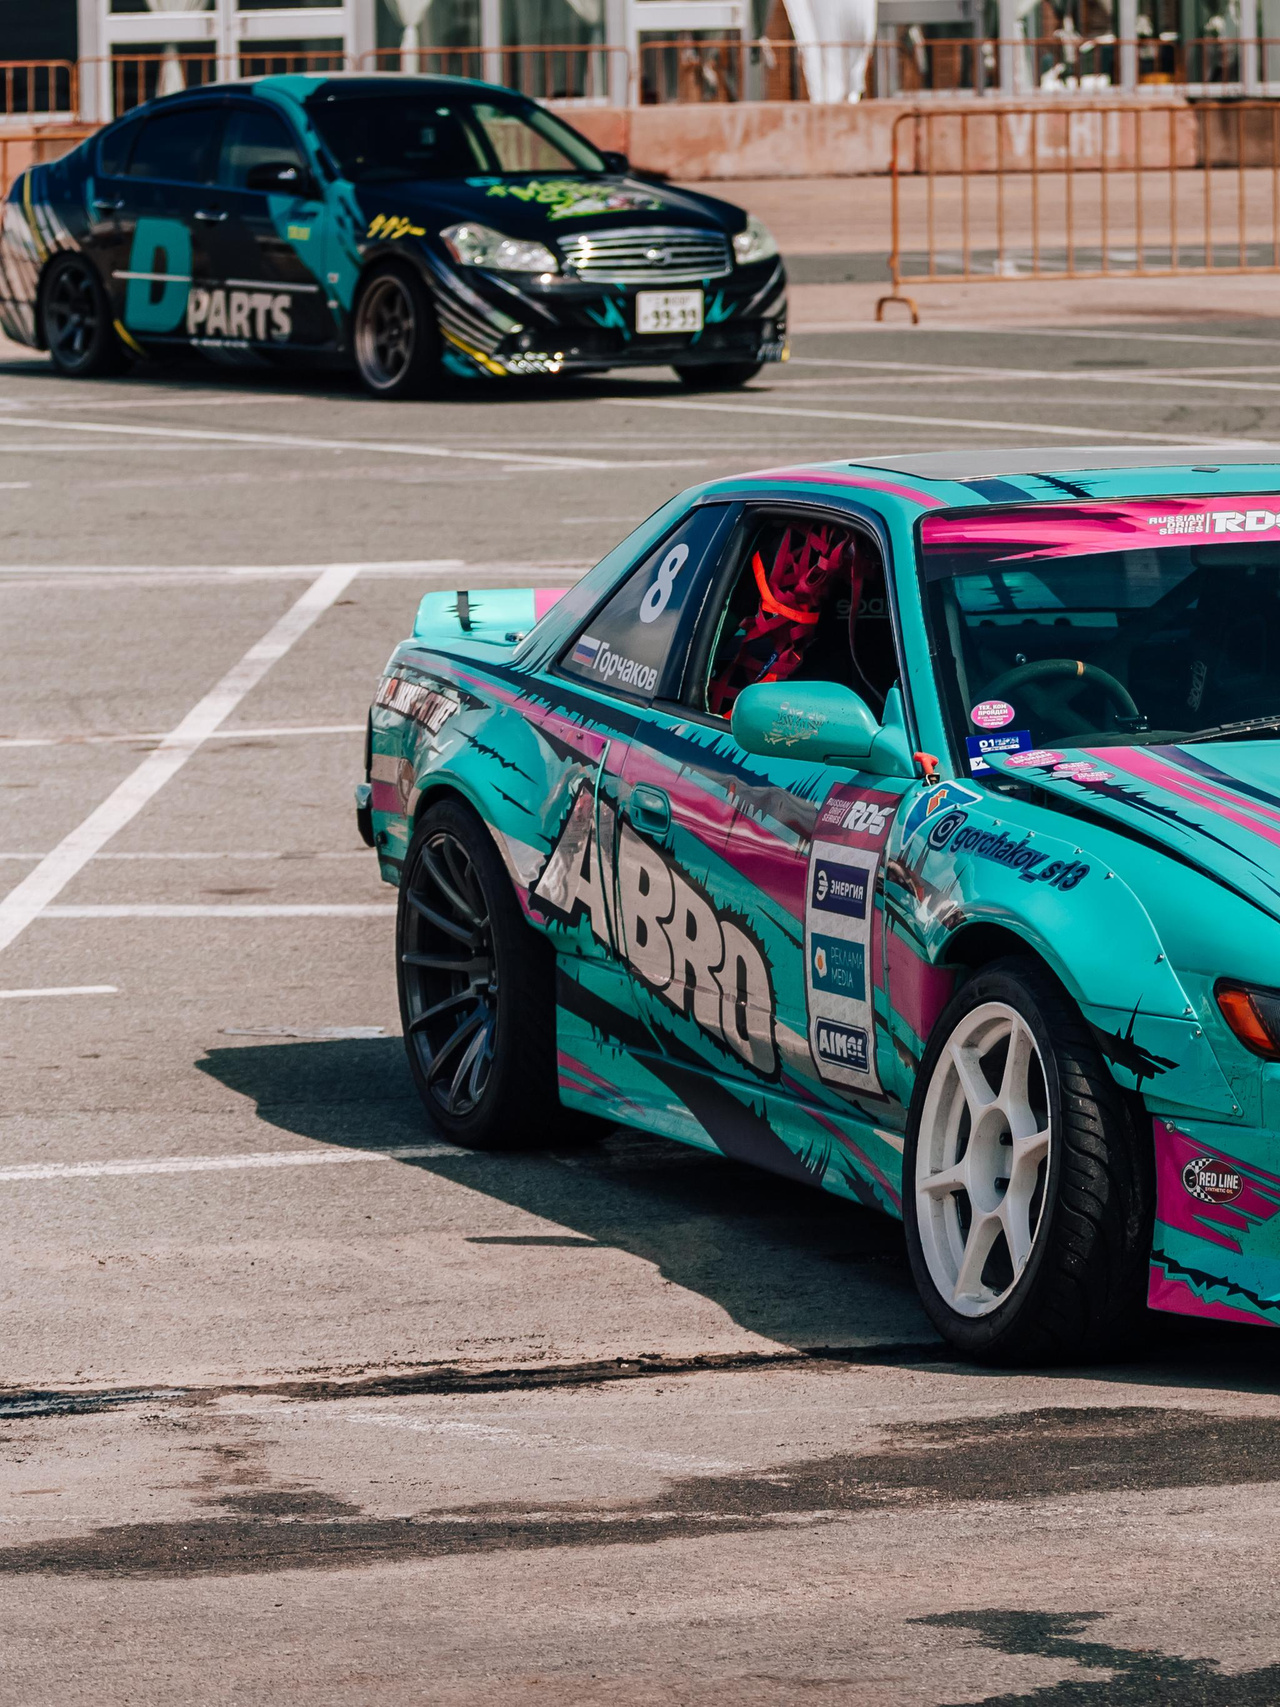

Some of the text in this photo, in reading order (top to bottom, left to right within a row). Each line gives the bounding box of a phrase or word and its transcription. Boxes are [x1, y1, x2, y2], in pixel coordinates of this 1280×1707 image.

[186, 289, 292, 341] PARTS
[1148, 513, 1204, 525] RUSSIAN
[1167, 520, 1203, 529] DRIFT
[1159, 526, 1204, 535] SERIES
[639, 543, 689, 624] 8
[592, 641, 658, 691] Горчаков
[826, 797, 851, 809] RUSSIAN
[829, 806, 846, 817] DRIFT
[821, 813, 841, 825] SERIES
[842, 800, 895, 835] RDS
[951, 826, 1091, 891] gorchakov_s13
[829, 880, 864, 901] ЭНЕРГИЯ
[533, 785, 776, 1075] ABRO
[831, 967, 854, 988] MEDIA
[819, 1029, 866, 1059] AIMOL
[1199, 1171, 1239, 1189] RED LINE
